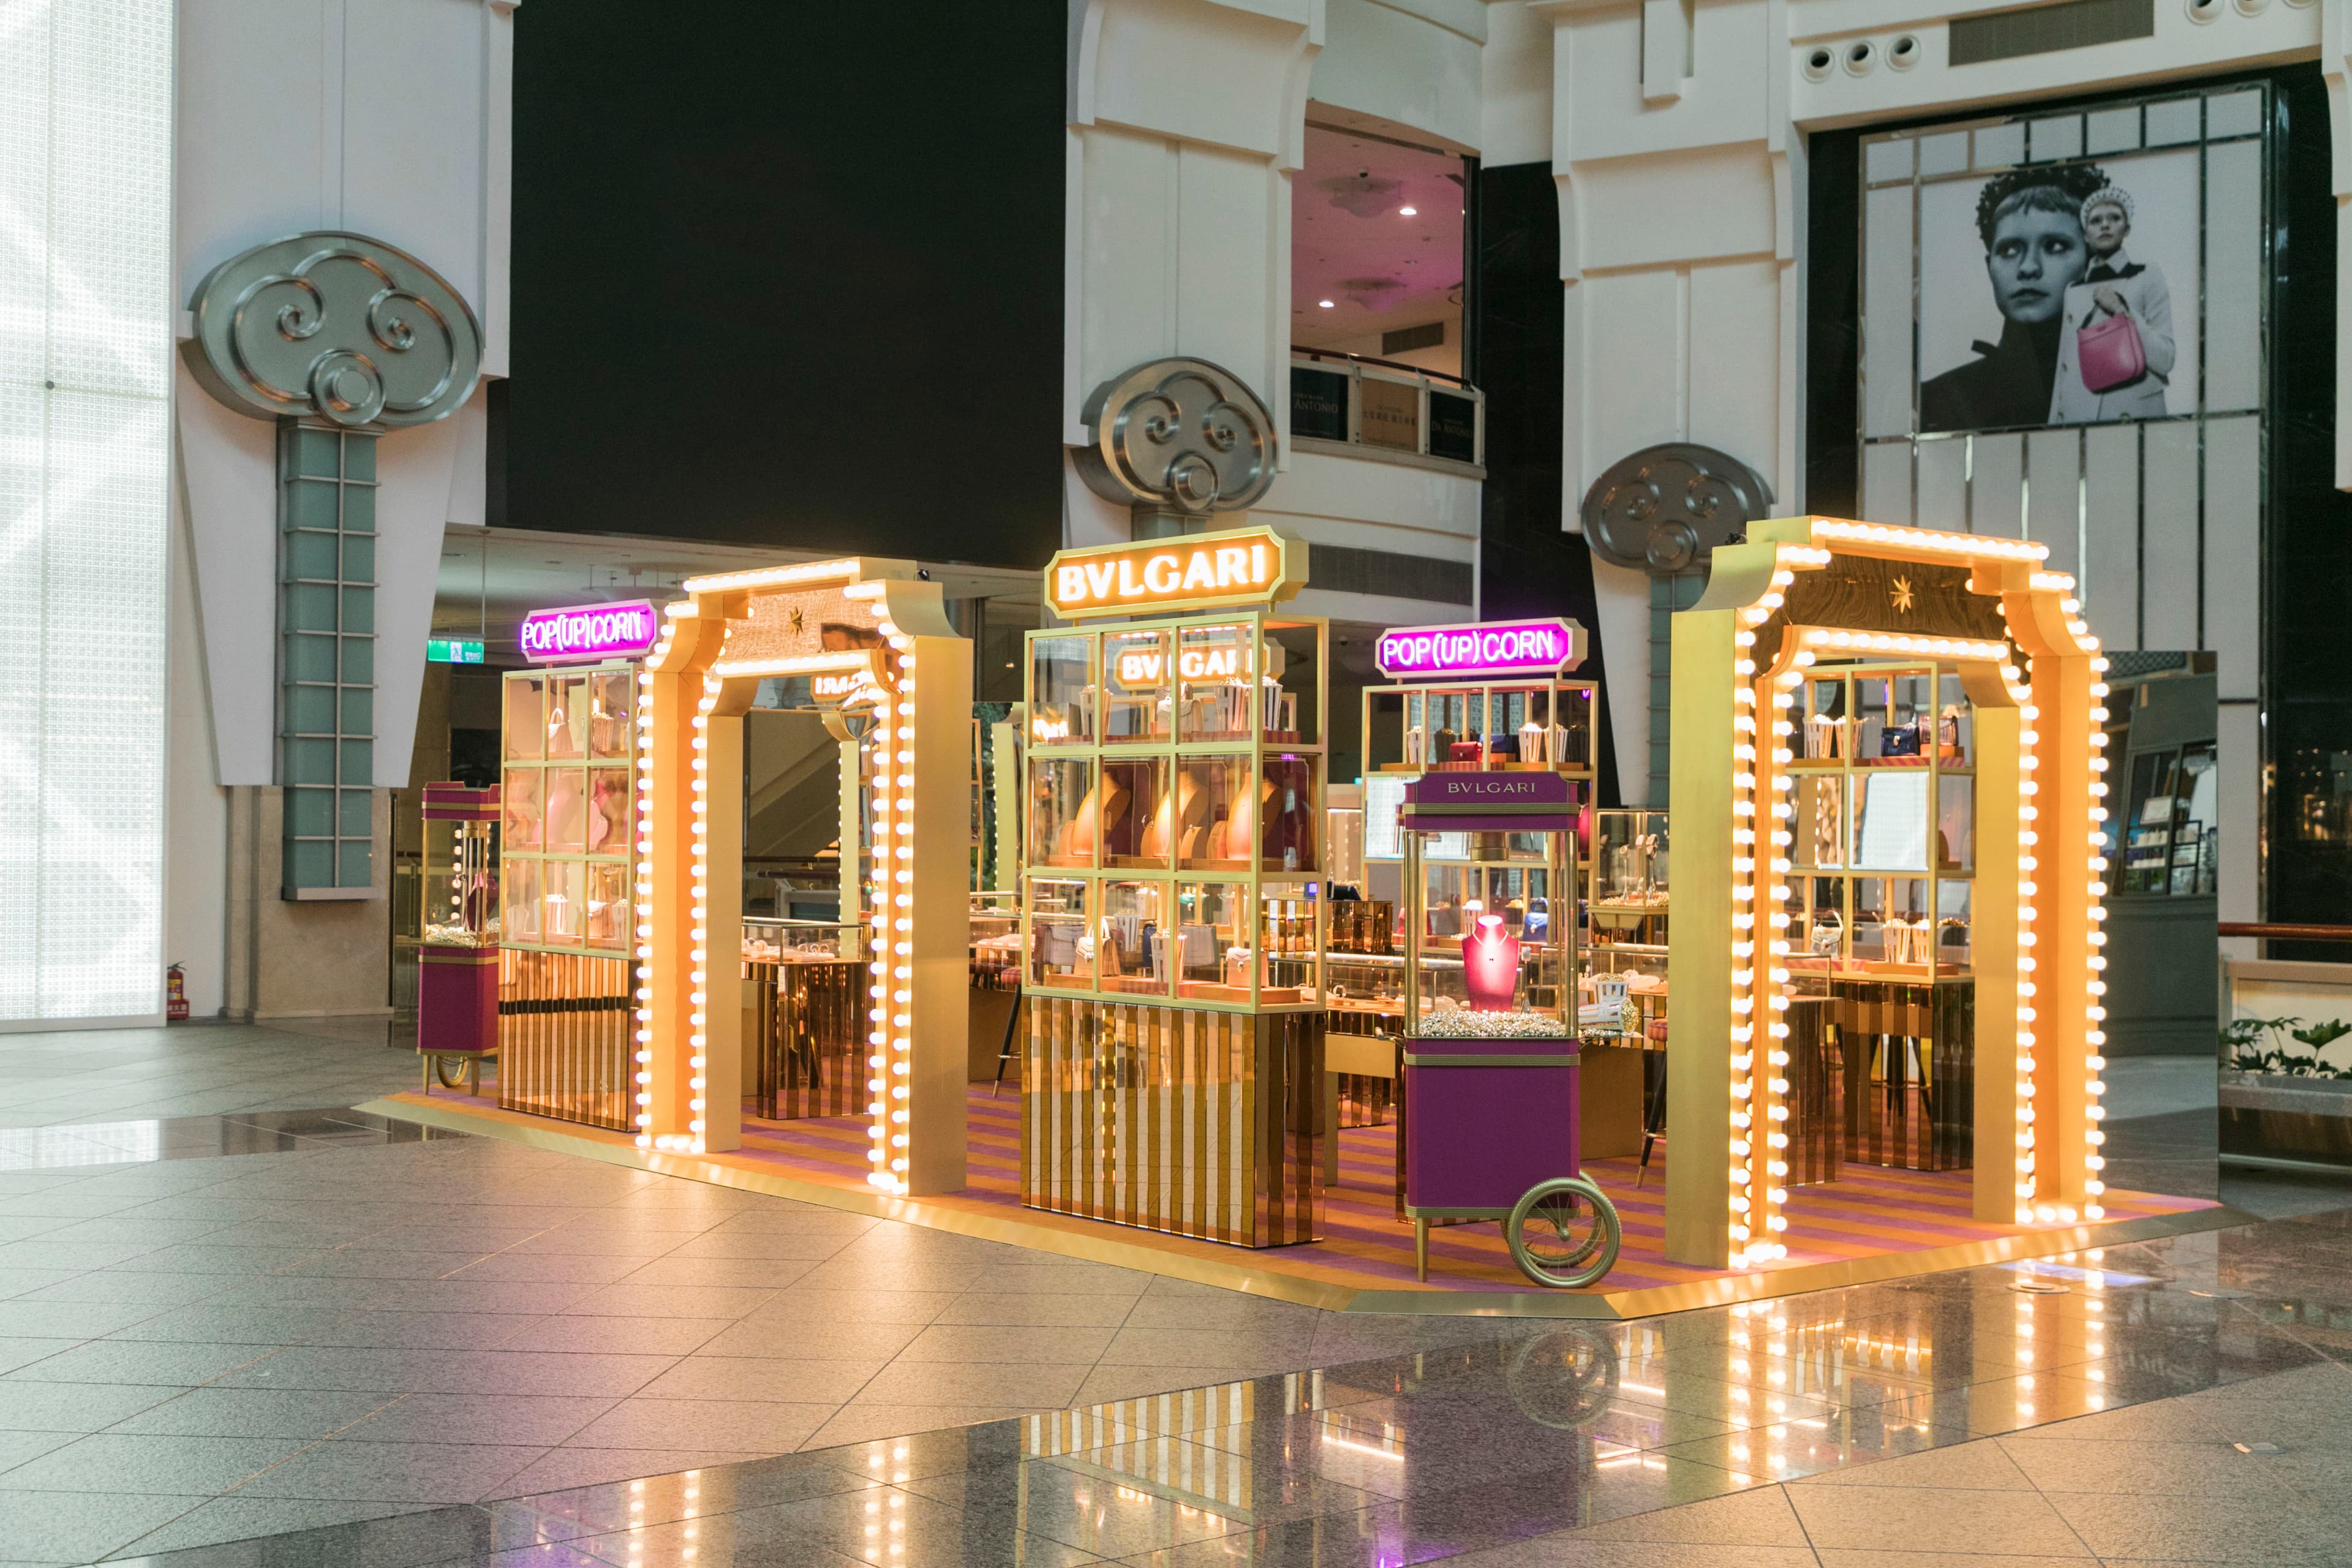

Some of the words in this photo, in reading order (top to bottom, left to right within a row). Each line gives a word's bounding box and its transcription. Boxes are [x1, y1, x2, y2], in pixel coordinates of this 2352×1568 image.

[1057, 545, 1265, 602] BVLGARI
[521, 610, 643, 652] POP(UP)CORN
[1382, 630, 1555, 668] POP(UP)CORN
[1447, 782, 1536, 794] BVLGARI
